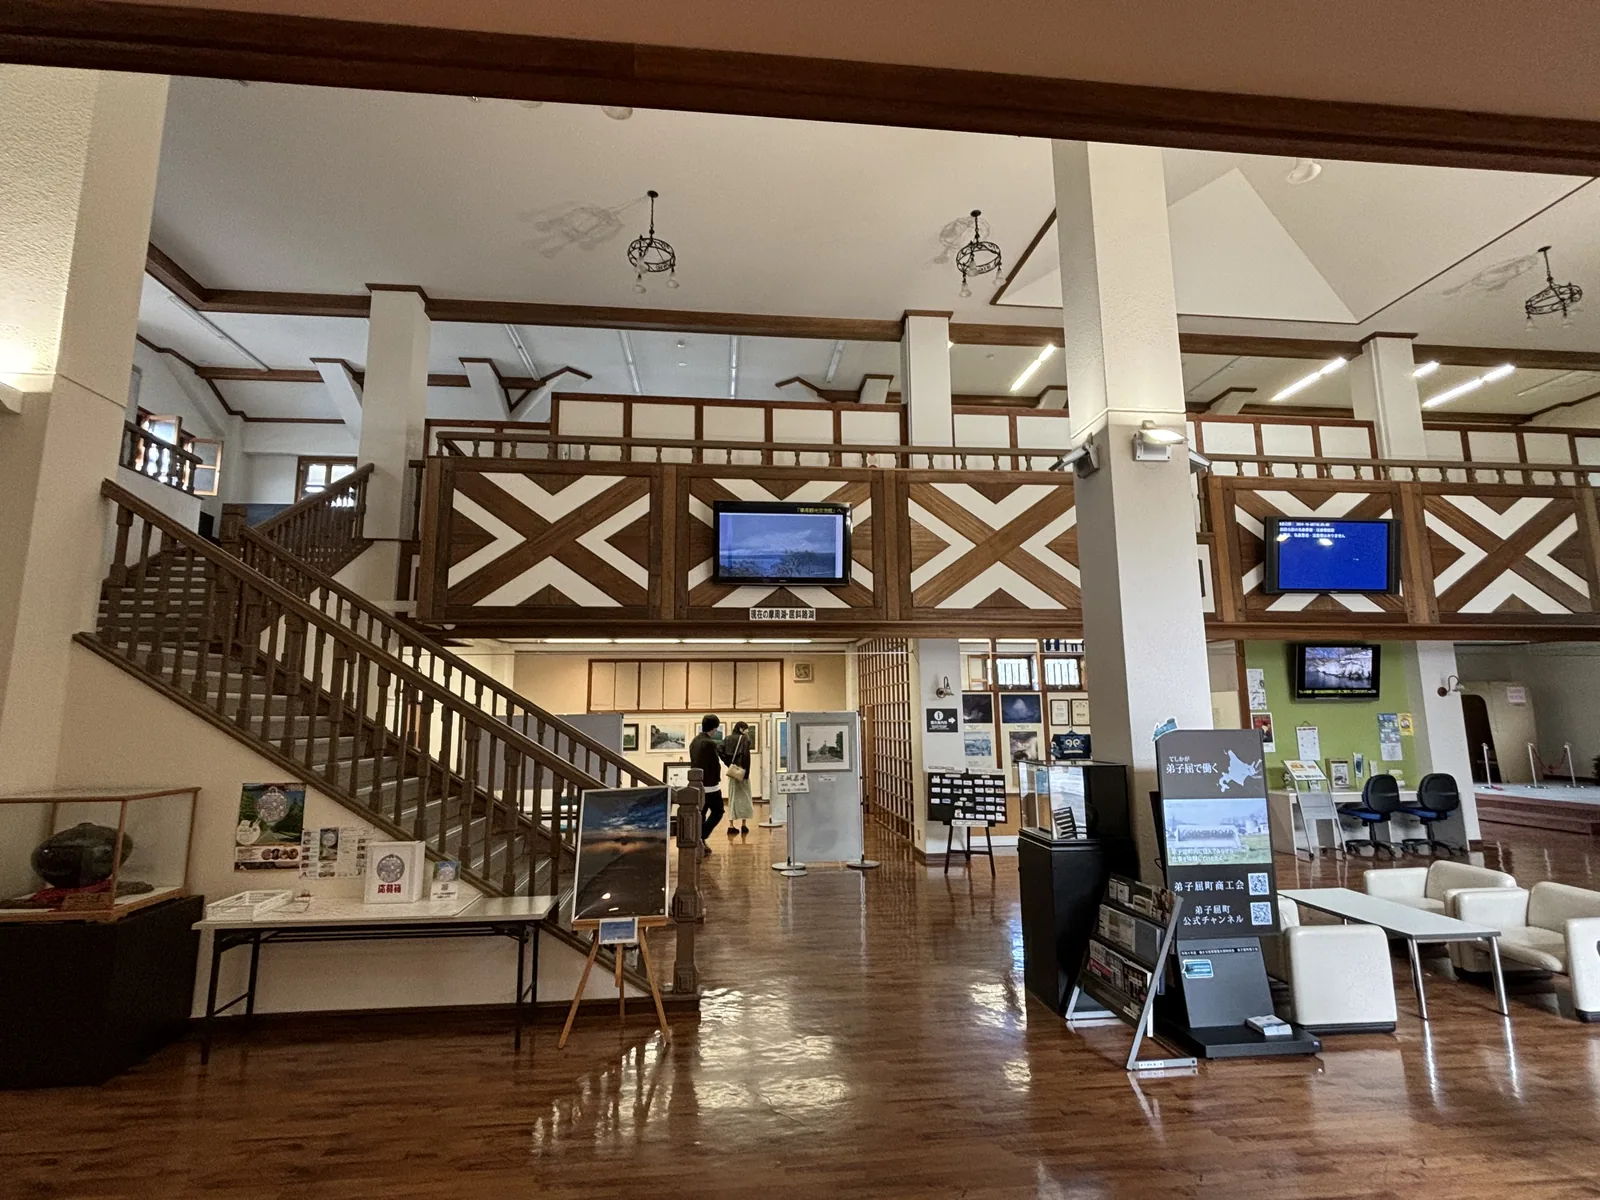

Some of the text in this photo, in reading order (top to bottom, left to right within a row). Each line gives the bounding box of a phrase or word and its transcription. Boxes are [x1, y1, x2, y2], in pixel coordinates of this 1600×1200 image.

[1166, 762, 1218, 774] 弟子屈で働く
[1174, 880, 1245, 892] 弟子屈町商工会
[1195, 904, 1230, 915] 弟子屈町
[1183, 914, 1244, 926] 公式チャンネル
